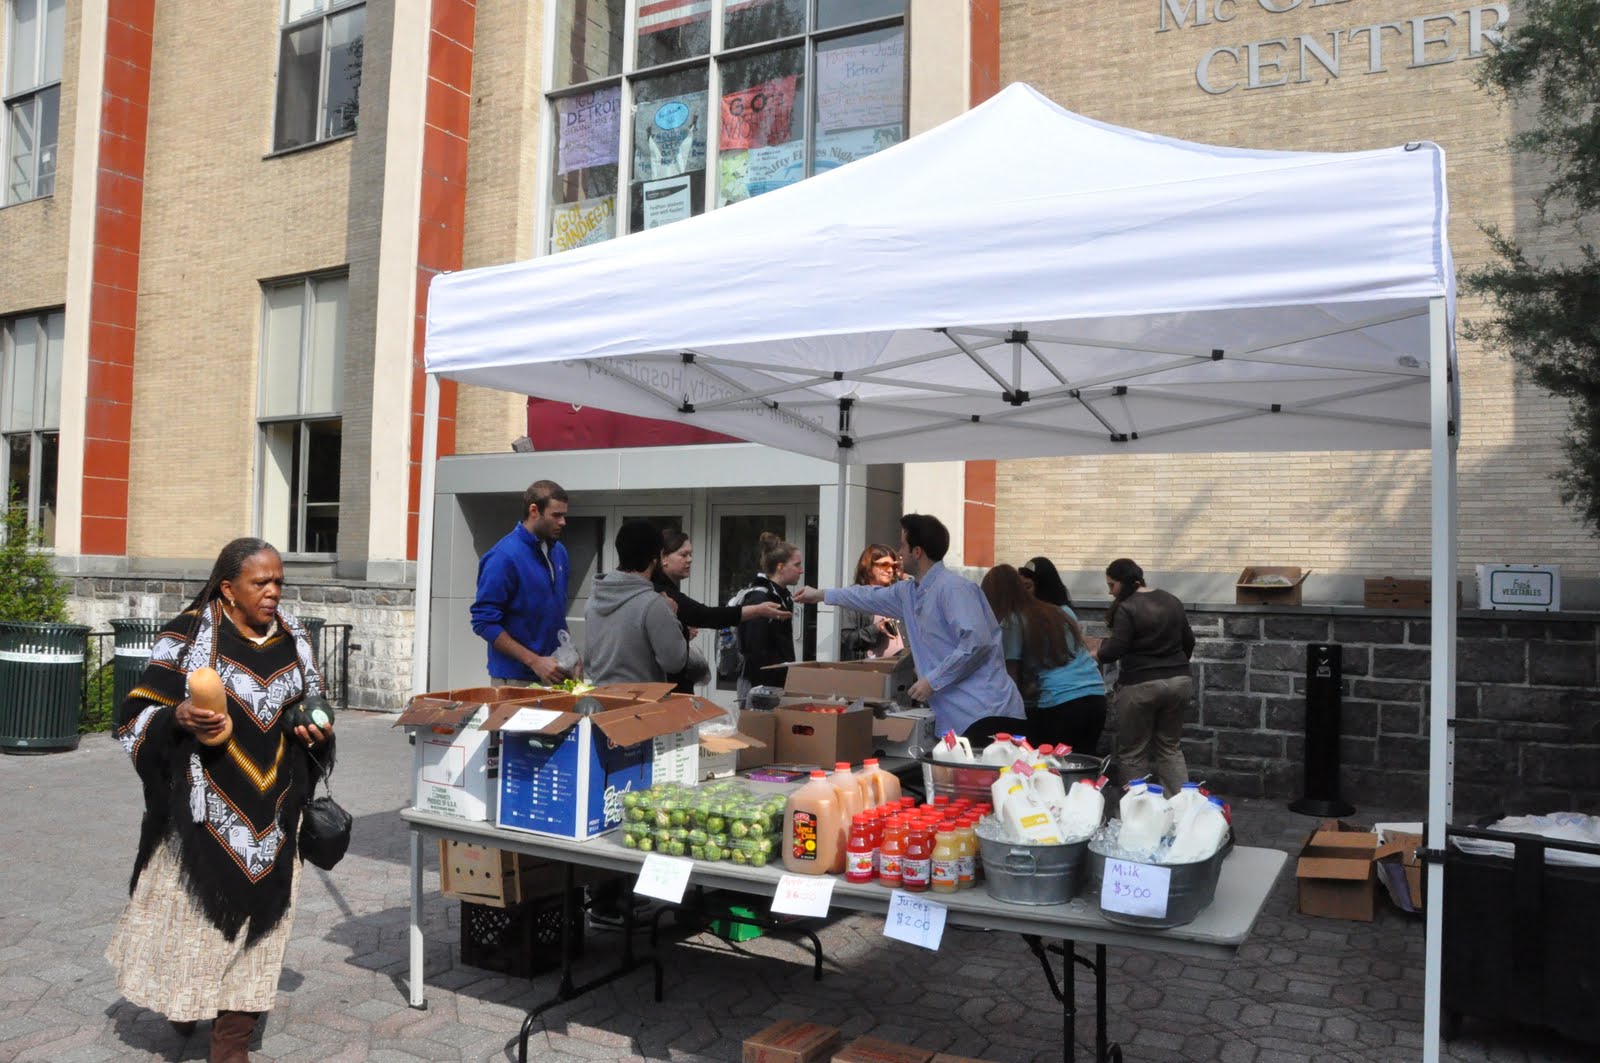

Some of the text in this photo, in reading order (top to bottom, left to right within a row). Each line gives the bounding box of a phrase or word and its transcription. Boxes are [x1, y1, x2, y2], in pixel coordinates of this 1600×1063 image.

[1194, 6, 1511, 94] CENTER
[1502, 588, 1542, 597] VEGETABLES
[1112, 864, 1140, 879] Milk
[896, 895, 929, 912] Juices
